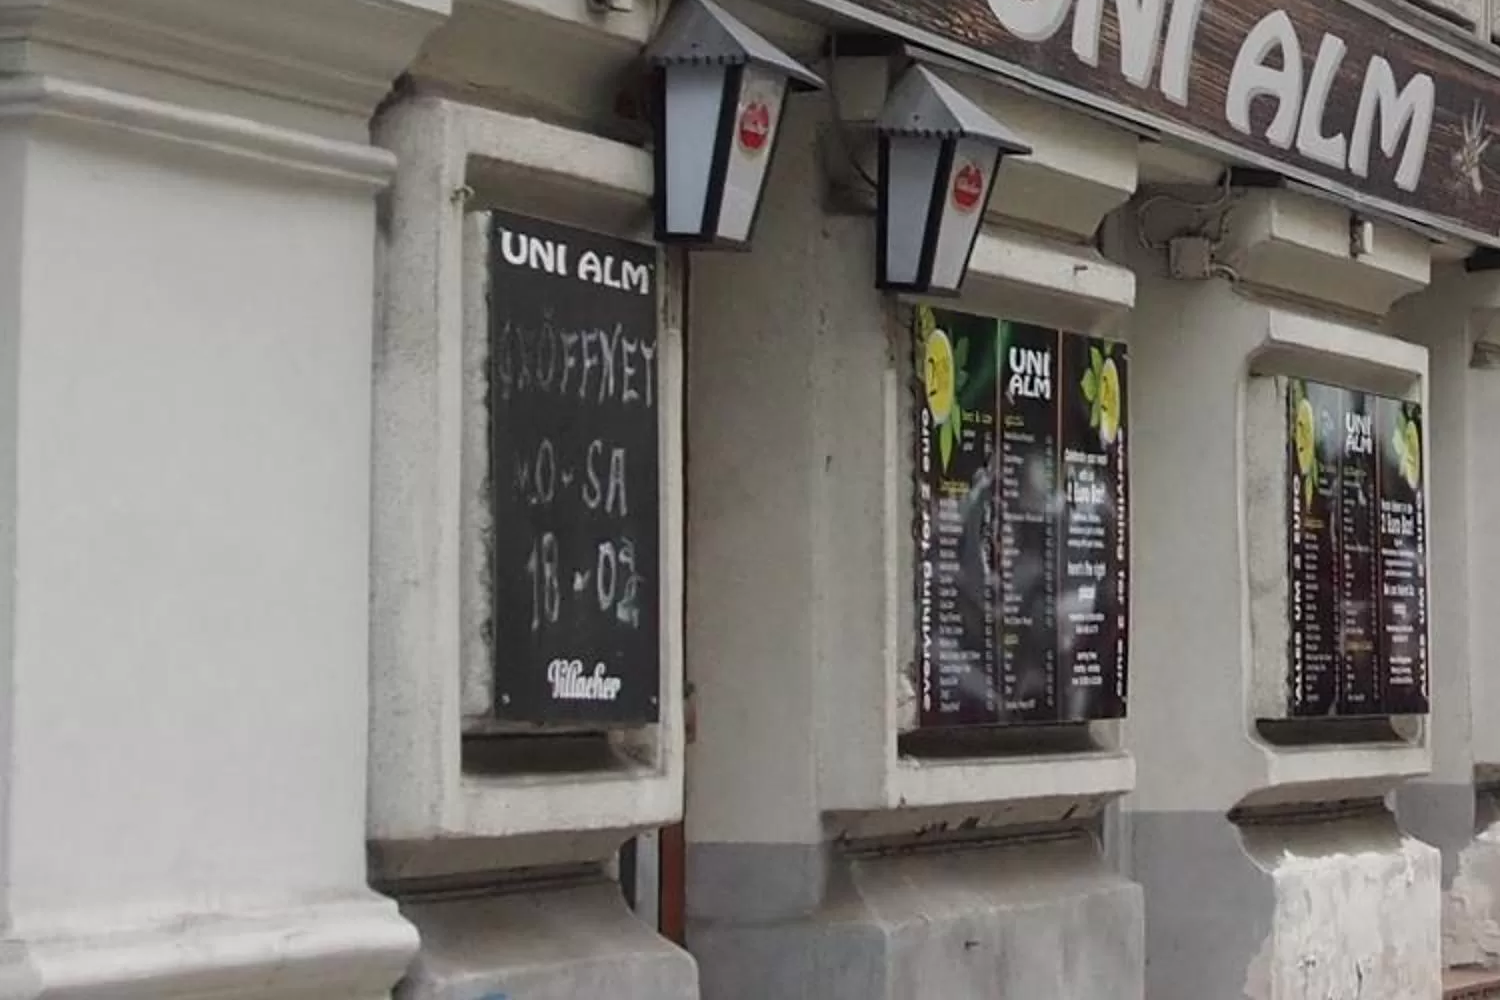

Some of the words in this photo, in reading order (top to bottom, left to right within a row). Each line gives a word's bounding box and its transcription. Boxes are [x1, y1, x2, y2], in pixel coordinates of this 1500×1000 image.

[1225, 8, 1436, 193] ALM
[501, 229, 568, 276] UNI
[577, 250, 650, 295] ALM
[1009, 347, 1051, 378] UNI
[1008, 373, 1051, 400] ALM
[921, 408, 931, 472] euro
[1345, 411, 1371, 435] UNI
[1345, 433, 1373, 455] ALM
[582, 438, 628, 517] SA
[921, 510, 931, 549] for
[921, 561, 933, 712] everything
[547, 658, 621, 700] Villacher
